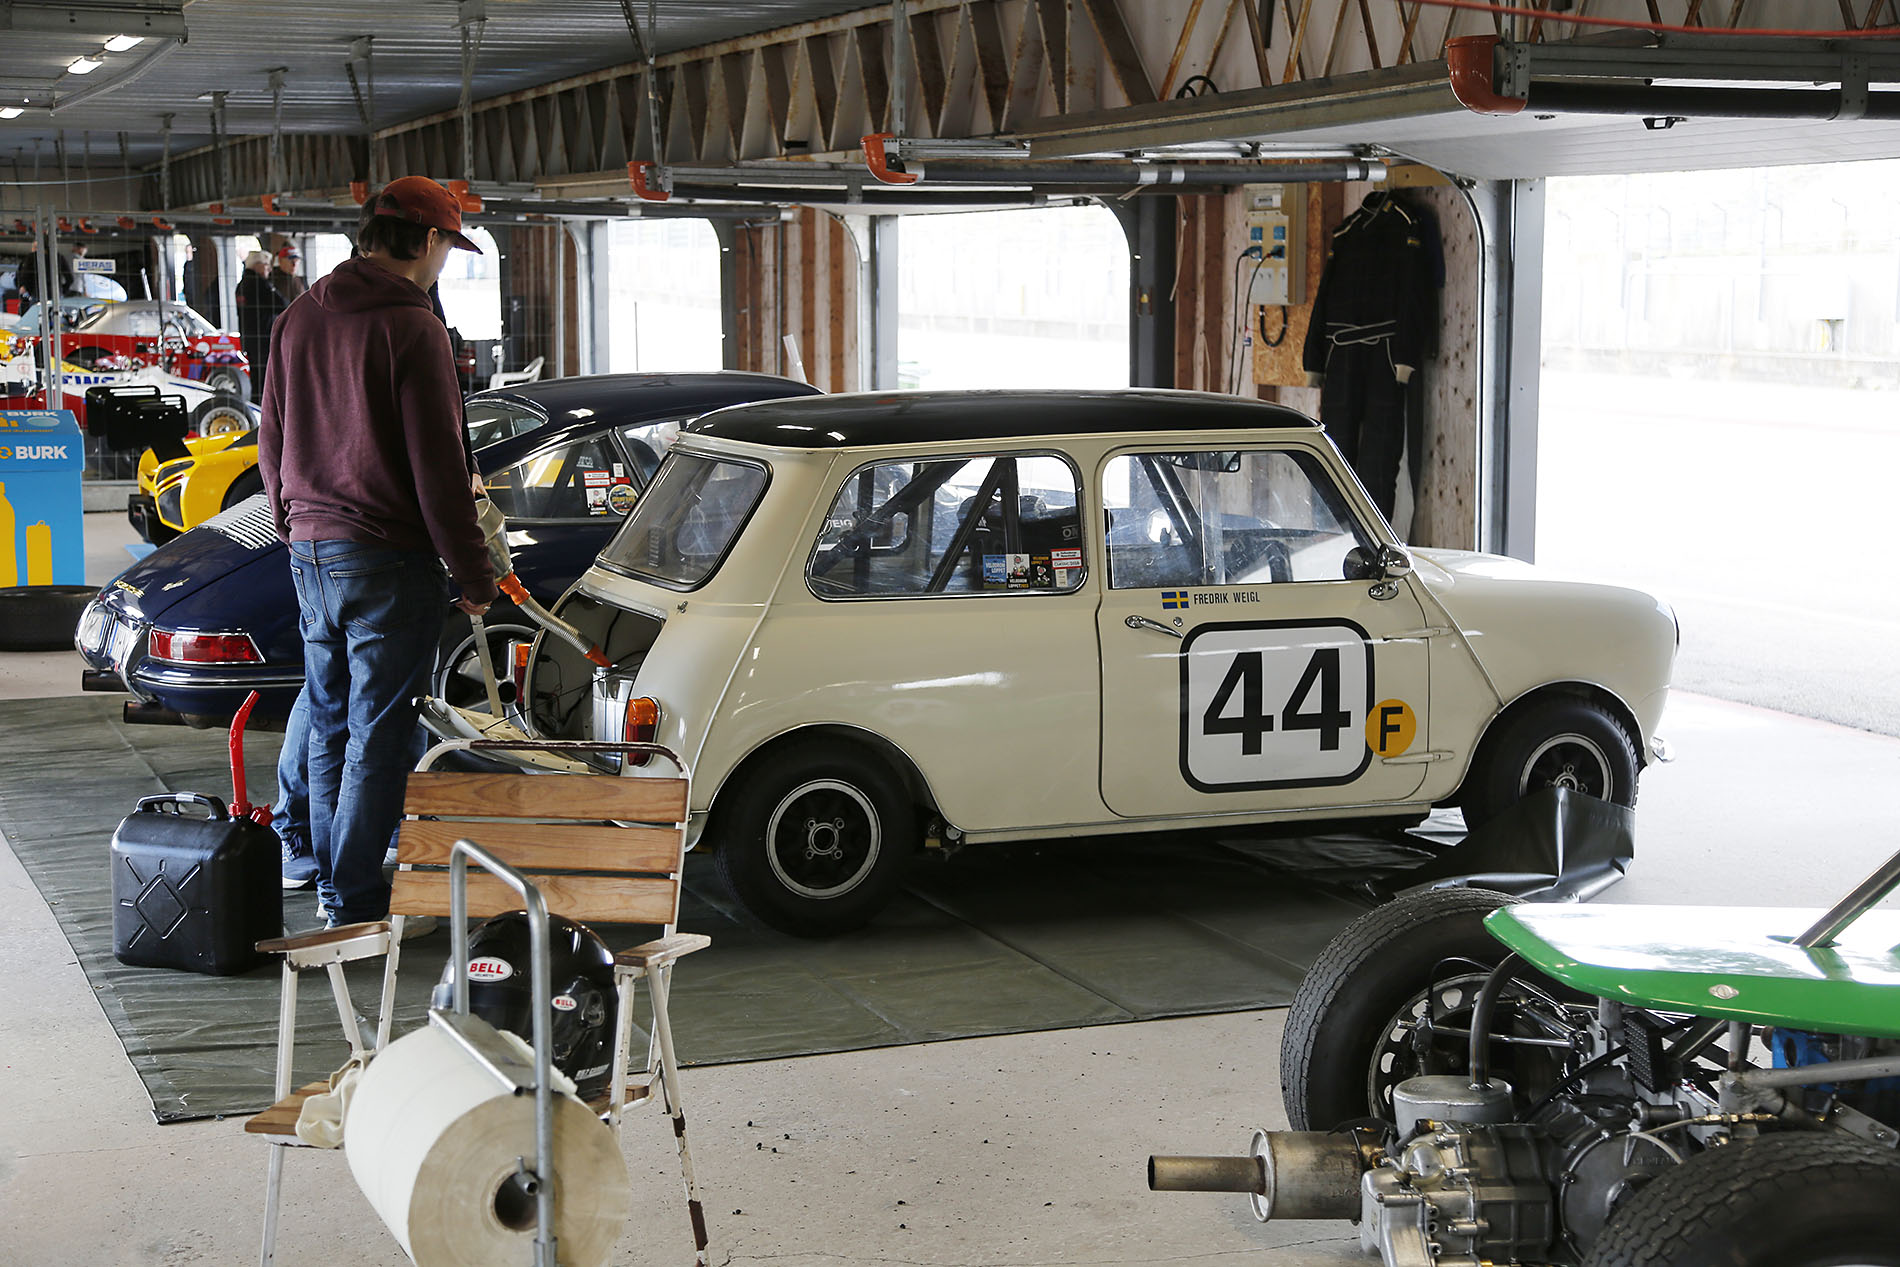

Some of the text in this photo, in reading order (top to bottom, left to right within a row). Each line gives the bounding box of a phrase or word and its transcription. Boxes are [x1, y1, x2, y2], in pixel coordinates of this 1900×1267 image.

[15, 446, 68, 460] BURK
[1194, 591, 1261, 605] FREDRIK WEIGL
[1203, 648, 1351, 756] 44
[1379, 706, 1403, 752] F
[470, 963, 504, 974] BELL
